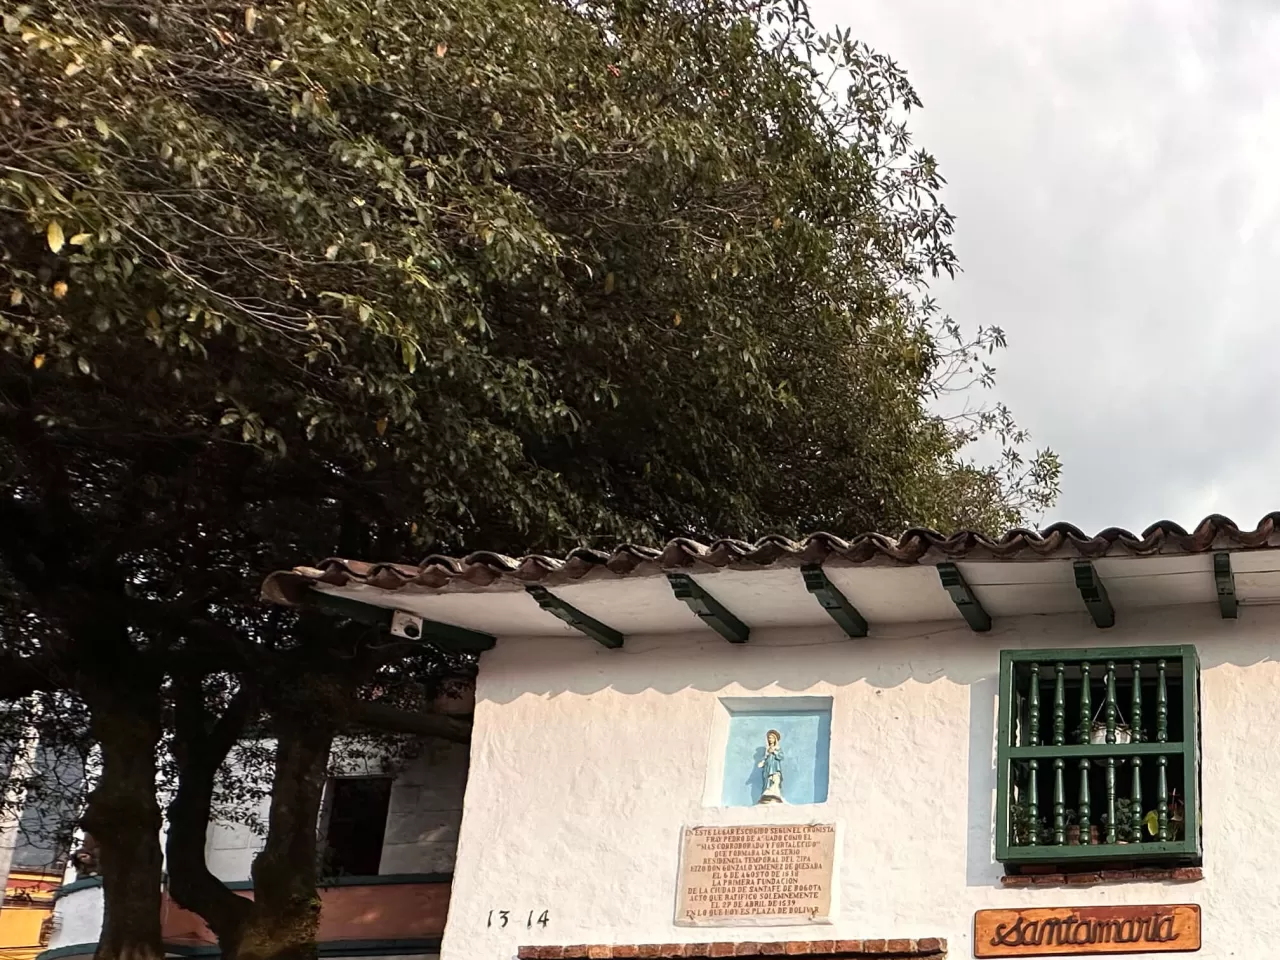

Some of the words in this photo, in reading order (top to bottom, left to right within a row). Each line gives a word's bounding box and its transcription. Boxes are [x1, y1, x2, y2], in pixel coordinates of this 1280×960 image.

[794, 863, 823, 871] QUESADA
[711, 886, 736, 894] CIUDAD
[749, 885, 780, 893] SANTAFE
[794, 884, 822, 892] BOGOTA
[709, 894, 723, 902] QUE
[725, 893, 758, 901] RATIFICO
[760, 892, 819, 900] SOLEMNEMENTE
[744, 900, 767, 908] ABRIL
[698, 909, 707, 917] LO
[709, 909, 723, 917] QUE
[740, 908, 750, 916] ES
[789, 906, 819, 914] BOLIVAR
[487, 909, 510, 928] 13
[526, 909, 550, 929] 14
